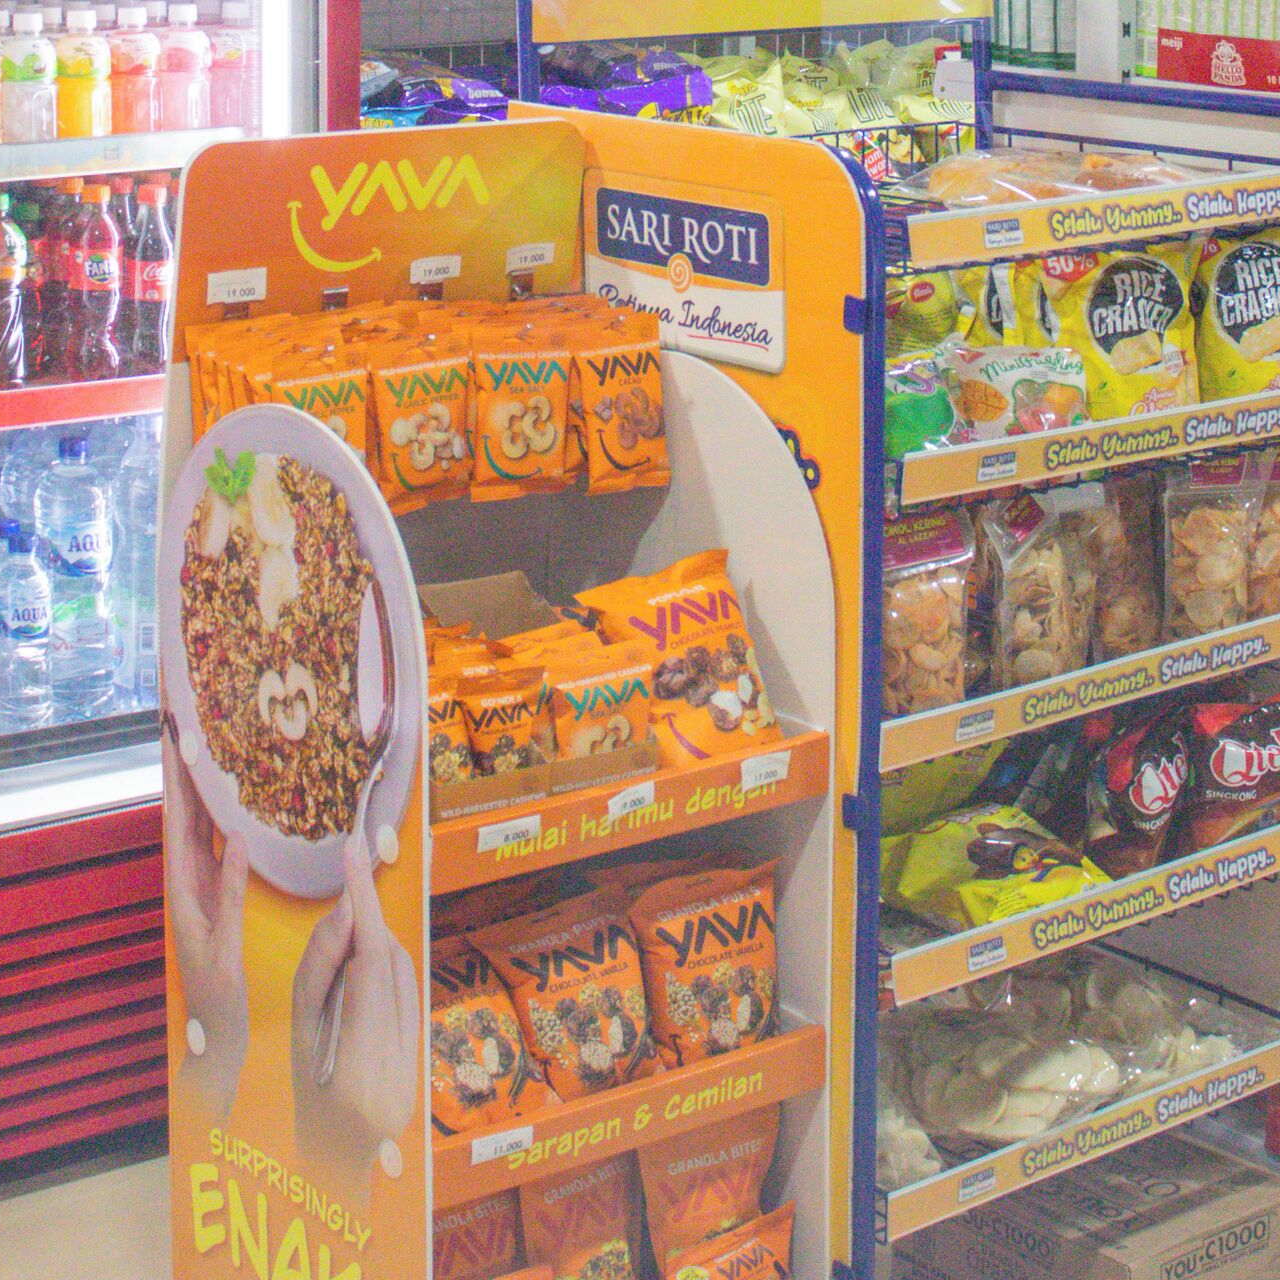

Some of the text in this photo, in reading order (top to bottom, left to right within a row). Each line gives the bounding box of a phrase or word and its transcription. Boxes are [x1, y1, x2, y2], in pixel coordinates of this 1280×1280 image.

[1161, 36, 1183, 50] meiji
[1212, 72, 1245, 85] PANDA
[1213, 62, 1242, 76] HELLO
[1266, 75, 1276, 84] 10
[310, 154, 492, 231] YAVA
[1051, 206, 1102, 239] Selalu
[1187, 192, 1232, 220] Selalu
[605, 203, 760, 266] SARI ROTI
[1115, 268, 1167, 302] RICE
[678, 299, 774, 345] Indonesia
[1092, 304, 1171, 337] CRACKER
[484, 360, 567, 392] YAVA
[1046, 442, 1099, 468] Selalu
[1185, 414, 1232, 441] Selalu
[68, 533, 113, 555] AQUA
[10, 604, 50, 622] AQUA
[564, 676, 649, 721] YAVA
[634, 1103, 652, 1132] &
[664, 1071, 763, 1122] Cemilan
[208, 1127, 374, 1252] SURPRISINGLY
